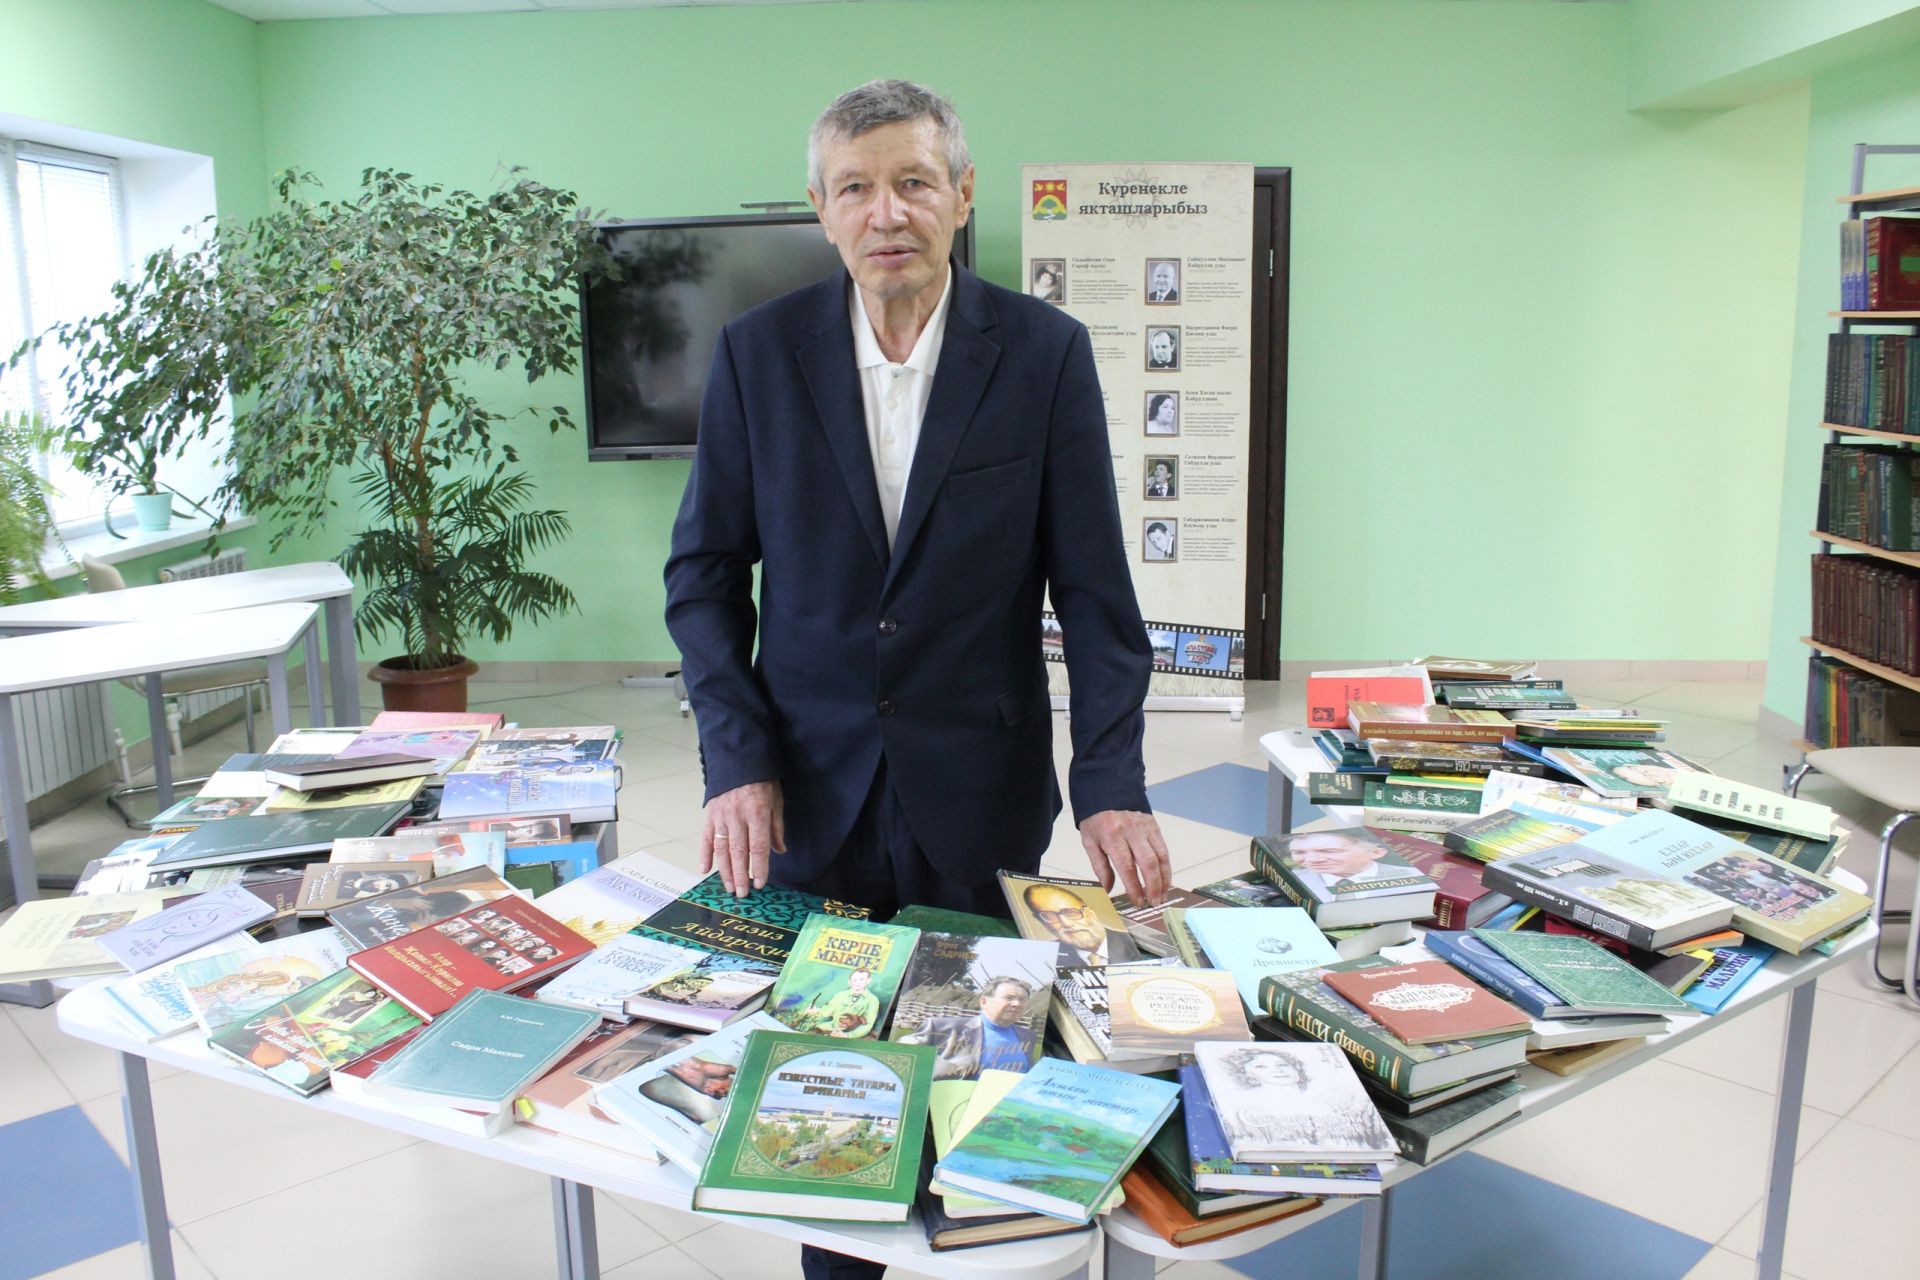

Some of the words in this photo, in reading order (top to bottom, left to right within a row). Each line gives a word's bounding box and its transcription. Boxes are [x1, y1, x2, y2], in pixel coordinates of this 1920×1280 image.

[1079, 203, 1208, 217] якташларыбыз
[721, 918, 785, 941] Газиз
[824, 937, 882, 957] КЕРПЕ
[814, 948, 881, 970] МЫЕГЫ
[1253, 957, 1319, 968] Древности
[1706, 952, 1754, 991] МАЛЬЧИК
[1296, 1009, 1332, 1043] ИЛЕ
[778, 1072, 845, 1088] ИЗВЕСТНЫЕ
[850, 1078, 897, 1092] ТАТАРЫ
[803, 1085, 867, 1100] ПРИКАМЬЯ
